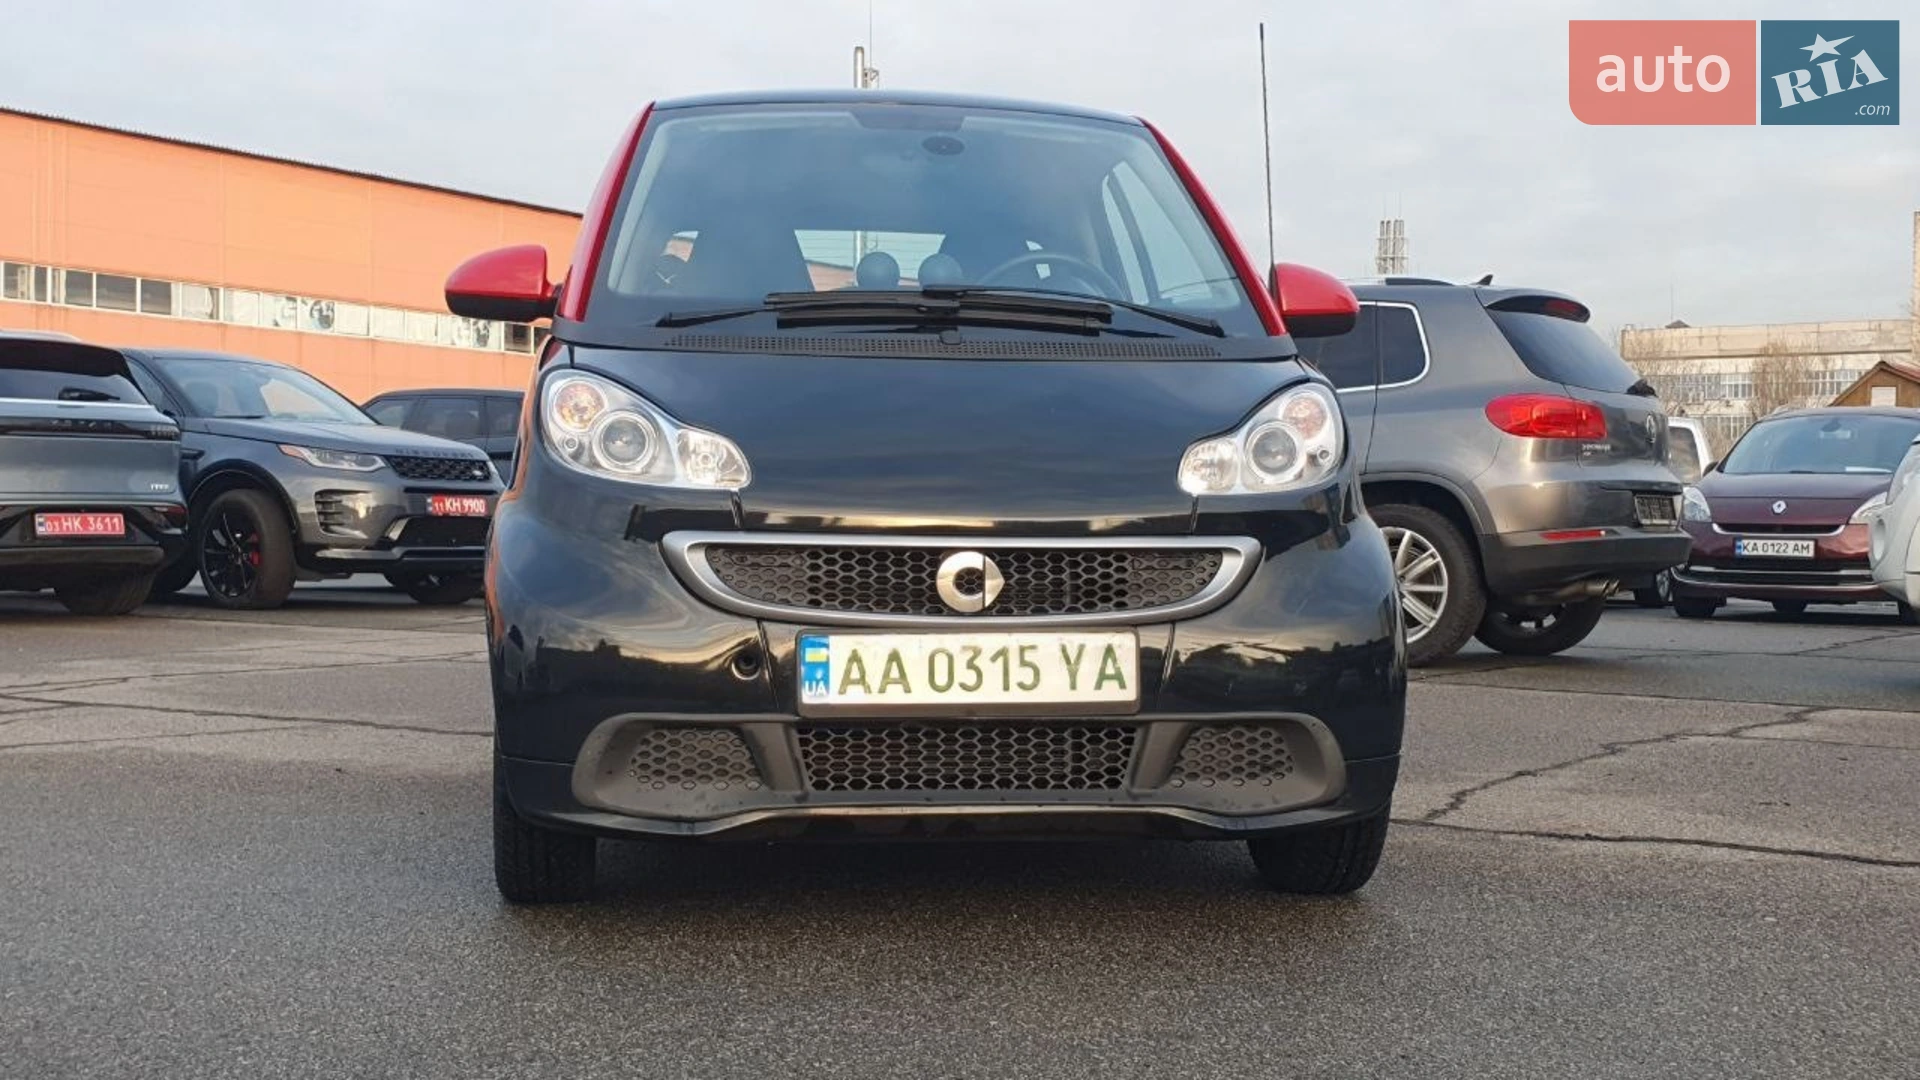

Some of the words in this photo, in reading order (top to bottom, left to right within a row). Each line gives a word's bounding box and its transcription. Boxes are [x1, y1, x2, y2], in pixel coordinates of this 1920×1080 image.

[462, 498, 486, 513] 9900
[62, 517, 83, 532] HK
[86, 516, 120, 531] 3611
[1742, 542, 1759, 553] KA
[1761, 542, 1789, 554] 0122
[1792, 543, 1810, 554] AM
[838, 648, 912, 695] AA
[928, 644, 1041, 694] 0315
[1060, 643, 1127, 691] YA
[804, 680, 826, 696] UA
